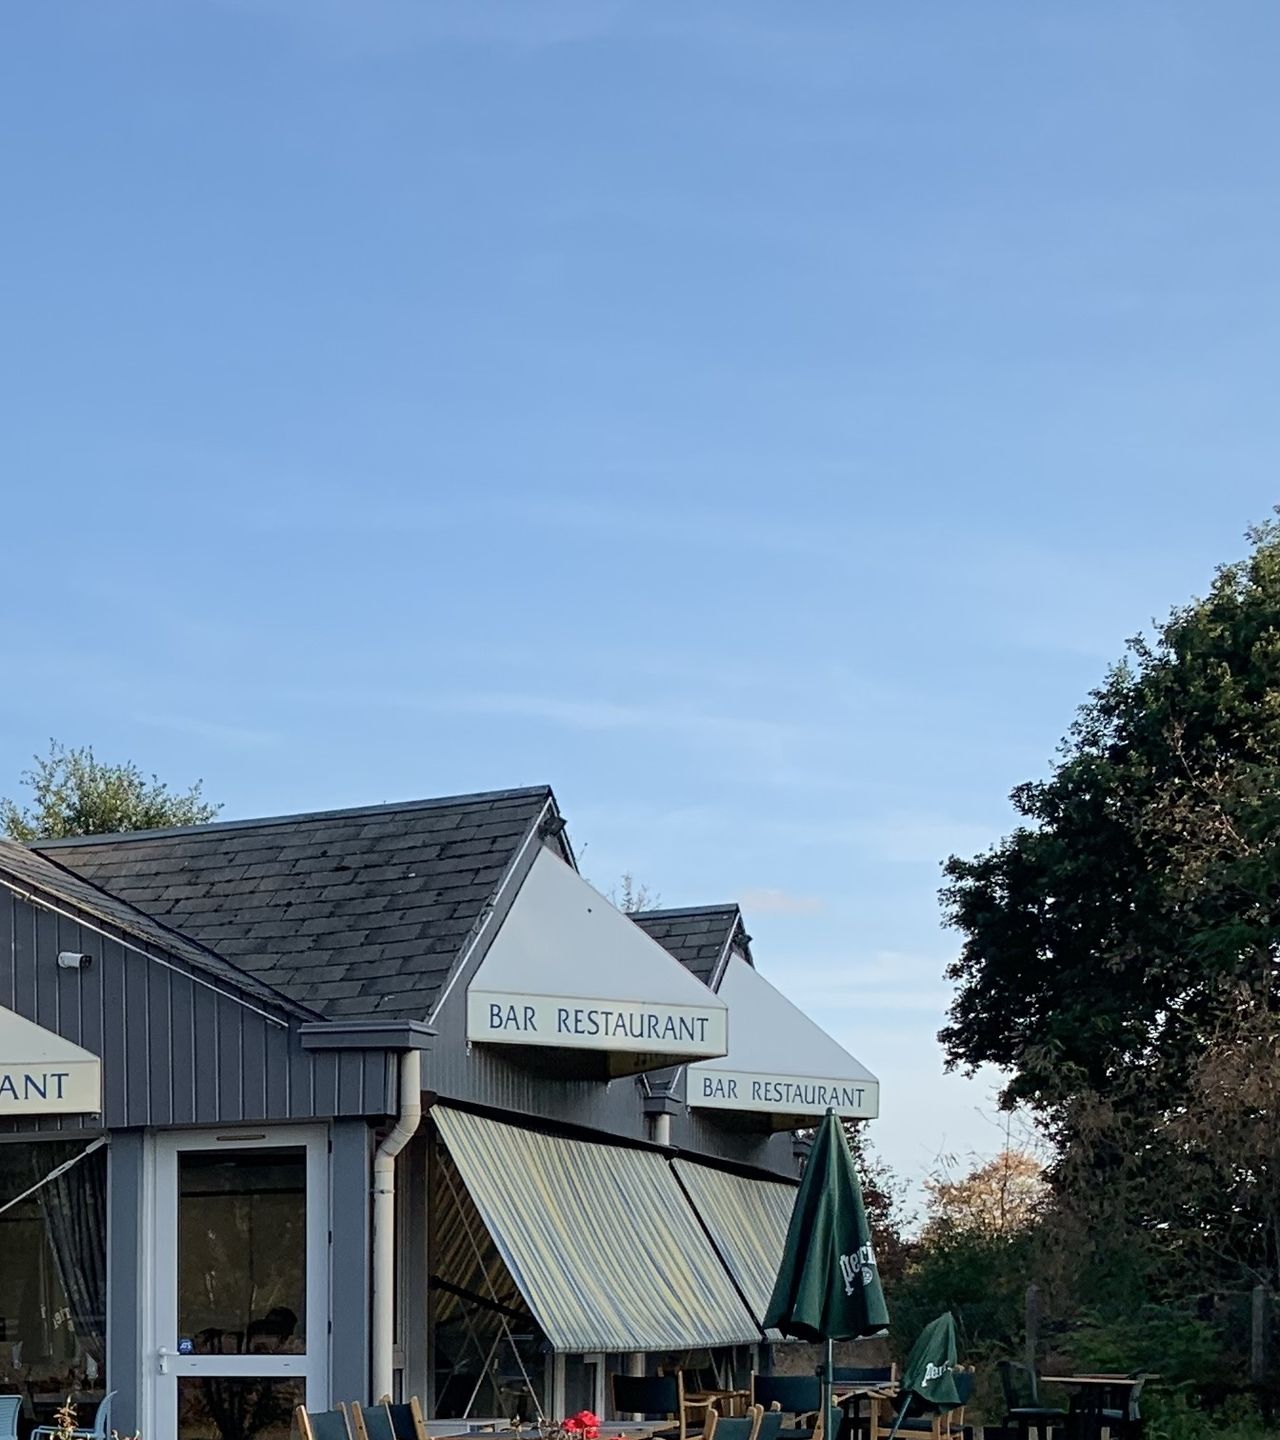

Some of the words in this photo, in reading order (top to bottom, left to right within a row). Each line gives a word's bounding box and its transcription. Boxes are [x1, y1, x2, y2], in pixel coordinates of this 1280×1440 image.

[489, 1003, 538, 1032] BAR
[557, 1008, 709, 1042] RESTAURANT
[702, 1077, 738, 1099] BAR
[751, 1081, 865, 1107] RESTAURANT
